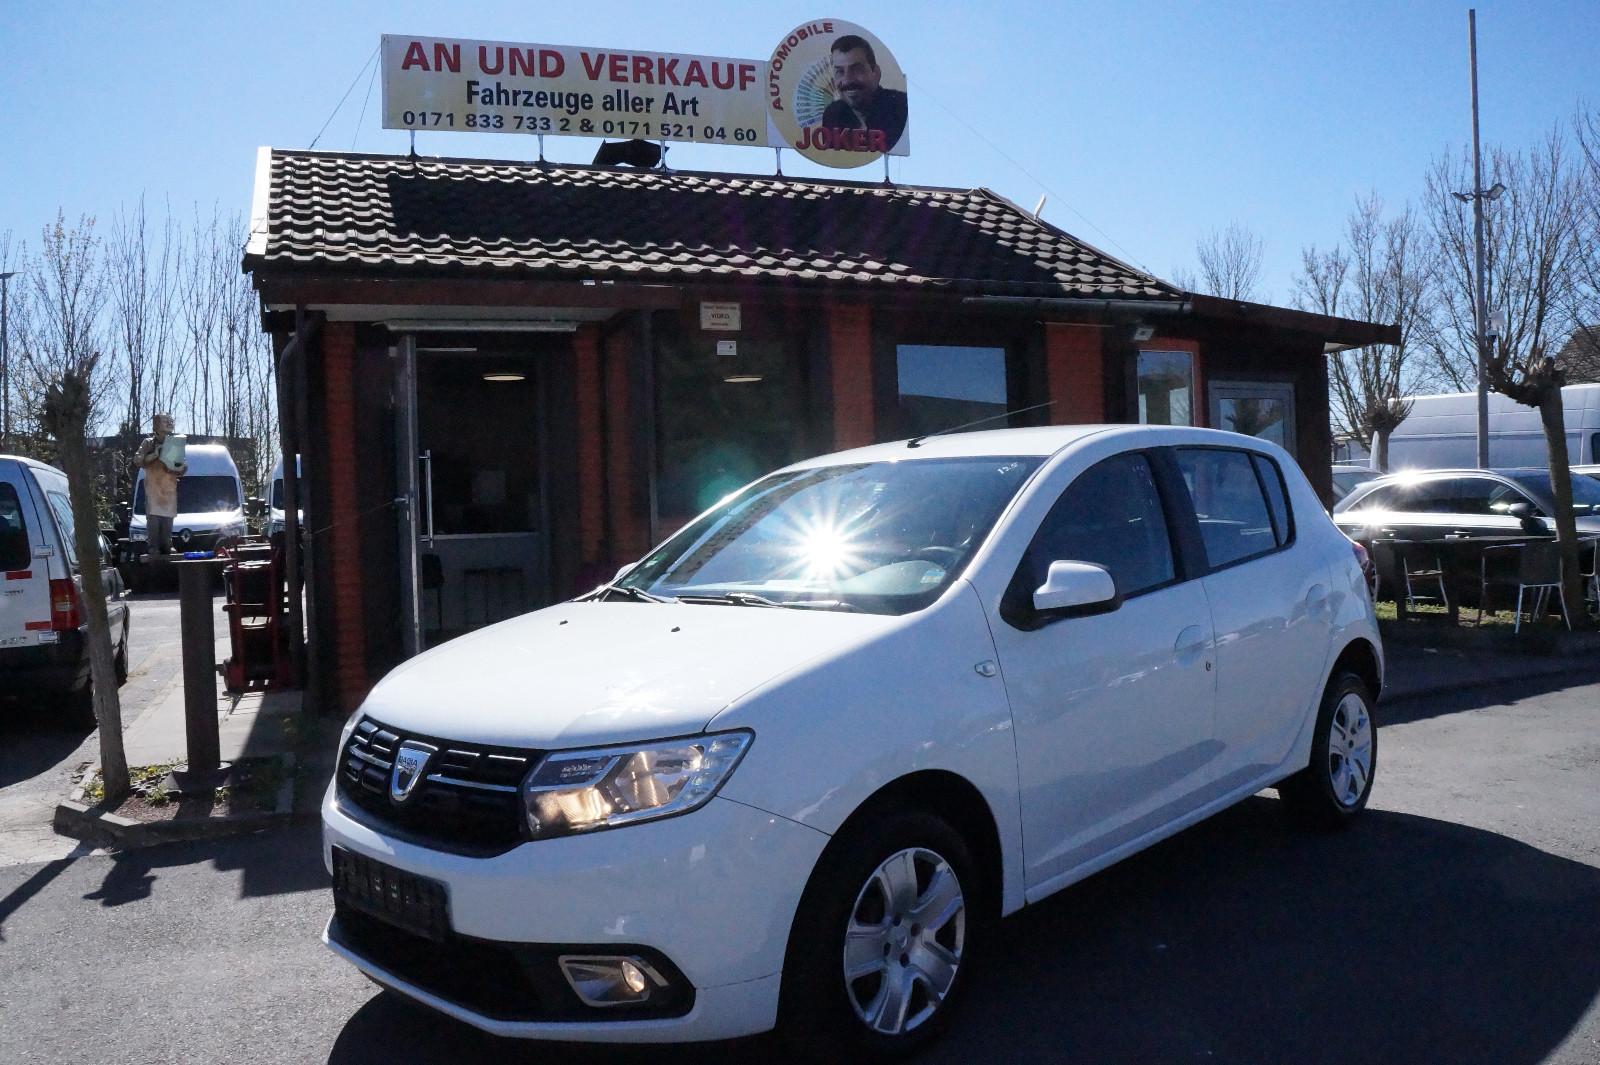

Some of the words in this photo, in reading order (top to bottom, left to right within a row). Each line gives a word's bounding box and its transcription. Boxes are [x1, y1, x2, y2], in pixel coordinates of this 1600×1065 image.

[401, 41, 461, 73] AN
[478, 45, 565, 78] UND
[579, 51, 756, 91] VERKAUF
[769, 22, 834, 112] AUTOMOBILE
[466, 80, 594, 115] Fahrzeuge
[602, 88, 655, 113] aller
[662, 91, 700, 117] Art
[402, 110, 455, 126] 0171
[465, 113, 504, 129] 833
[513, 115, 551, 131] 733
[559, 117, 570, 132] 2
[579, 118, 595, 133] &
[602, 120, 650, 135] 0171
[660, 123, 694, 138] 521
[703, 125, 727, 140] 04
[734, 127, 757, 142] 60
[795, 126, 889, 153] JOKER
